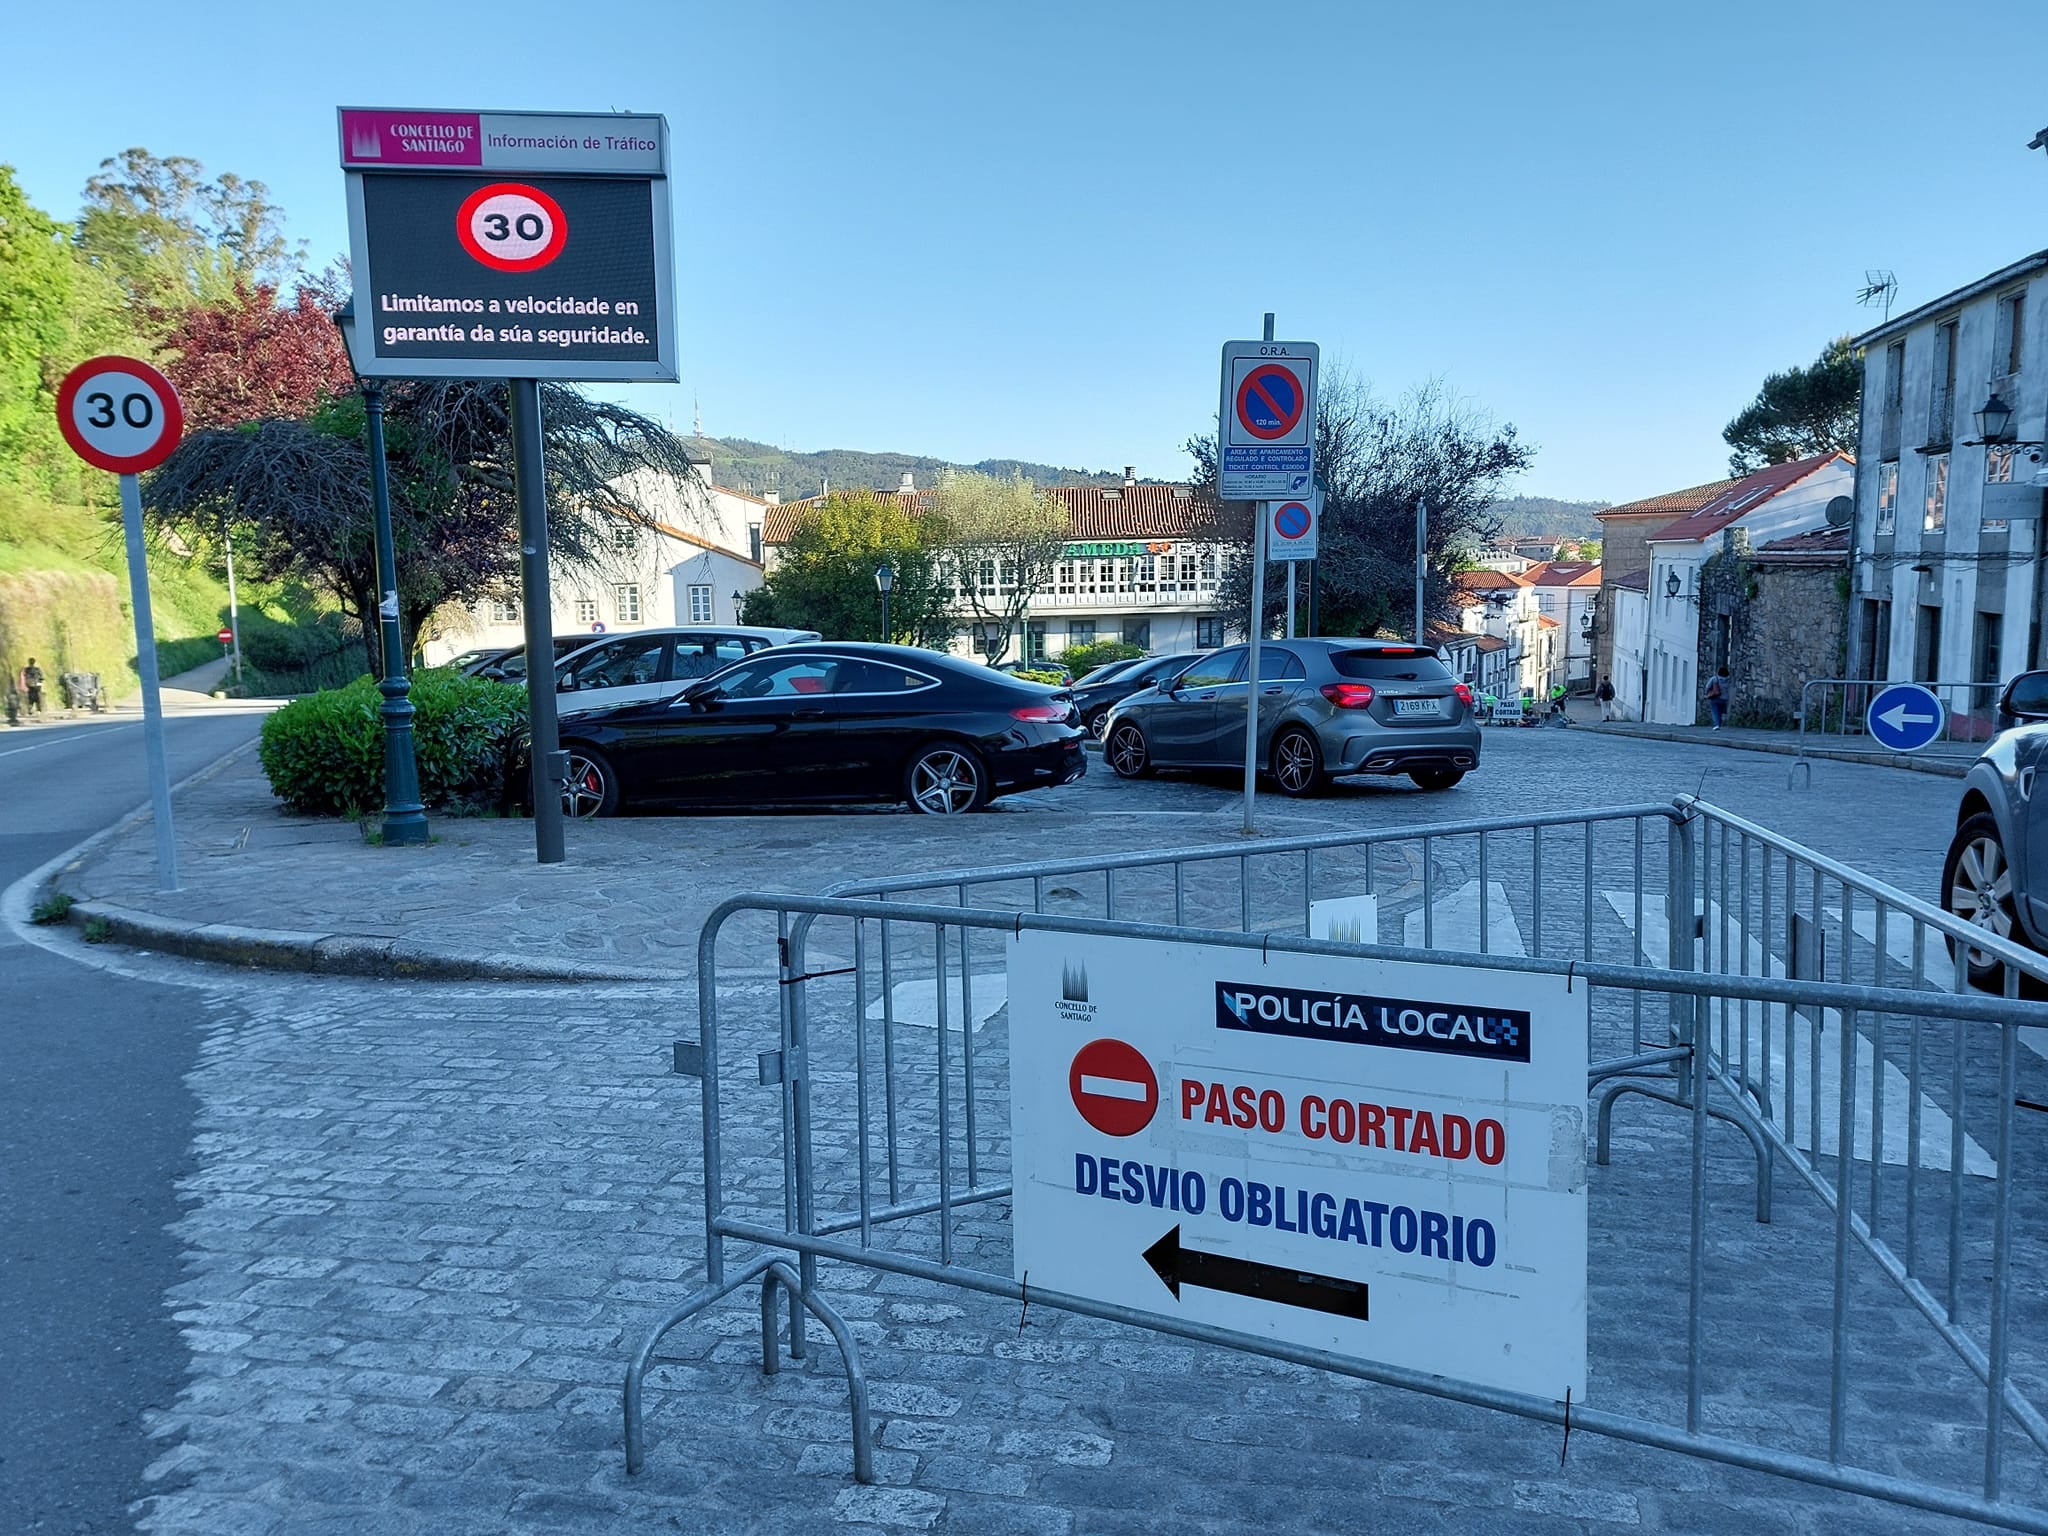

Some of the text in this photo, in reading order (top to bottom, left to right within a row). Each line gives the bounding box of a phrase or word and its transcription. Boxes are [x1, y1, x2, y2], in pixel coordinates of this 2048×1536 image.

[390, 123, 474, 139] CONCELLO DE
[401, 139, 465, 153] SANTIAGO
[488, 132, 657, 152] Información de Tráfico
[483, 213, 544, 241] 30
[381, 293, 639, 316] Limitamos a velocidade en
[383, 325, 650, 348] garantía da súa seguridade.
[1260, 346, 1290, 356] O.R.A.
[86, 392, 153, 429] 30
[1256, 418, 1267, 426] 120
[1400, 700, 1421, 710] 2169
[1054, 1001, 1098, 1013] CONCELLO DE
[1060, 1012, 1092, 1022] SANTIAGO
[1235, 992, 1497, 1045] POLICÍA LOCAL
[1181, 1078, 1506, 1166] PASO CORTADO
[1075, 1153, 1497, 1268] DESVIO OBLIGATORIO
